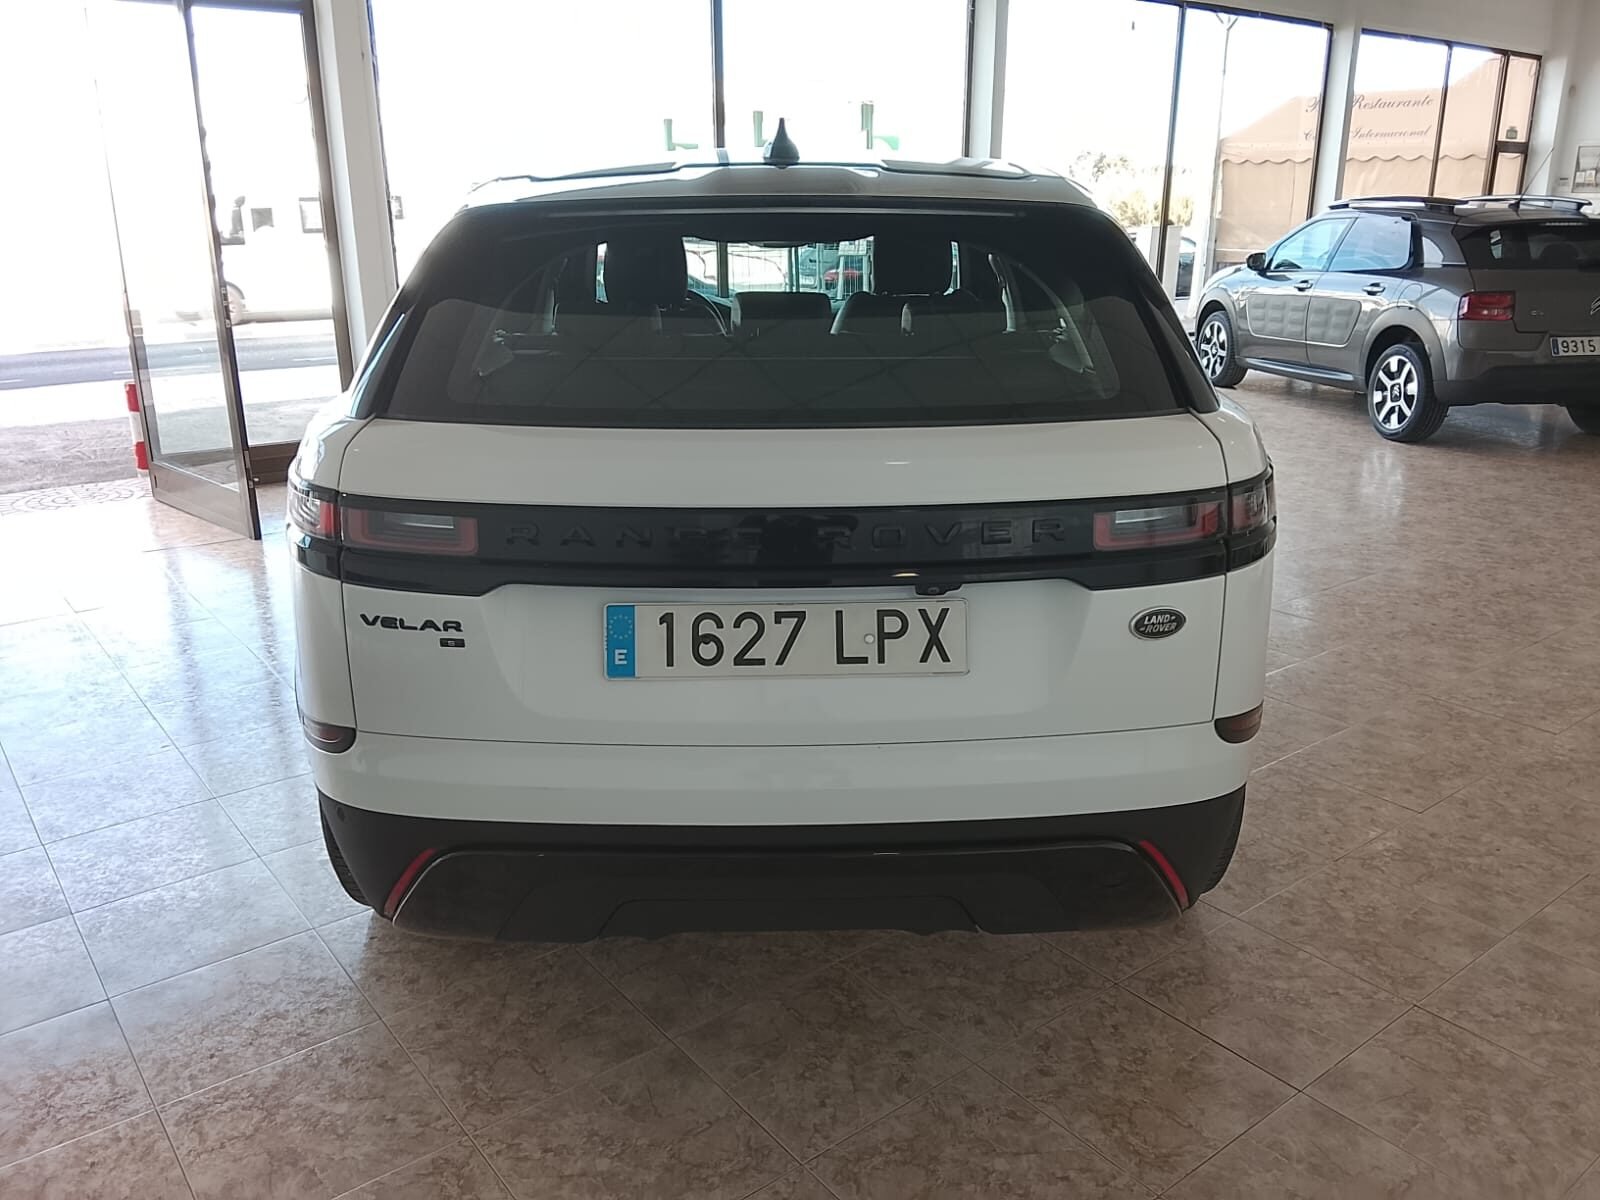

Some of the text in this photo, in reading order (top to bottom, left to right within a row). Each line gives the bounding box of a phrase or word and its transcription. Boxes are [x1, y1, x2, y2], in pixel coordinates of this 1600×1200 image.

[1352, 94, 1434, 110] Restaurante
[1350, 124, 1432, 139] Internacional
[1560, 339, 1597, 353] 9315
[816, 519, 1065, 548] ROVER
[360, 613, 463, 632] VELAR
[1143, 614, 1171, 625] LAND
[1144, 622, 1177, 633] ROVER
[658, 607, 952, 668] 1627 LPX
[614, 648, 628, 665] E
